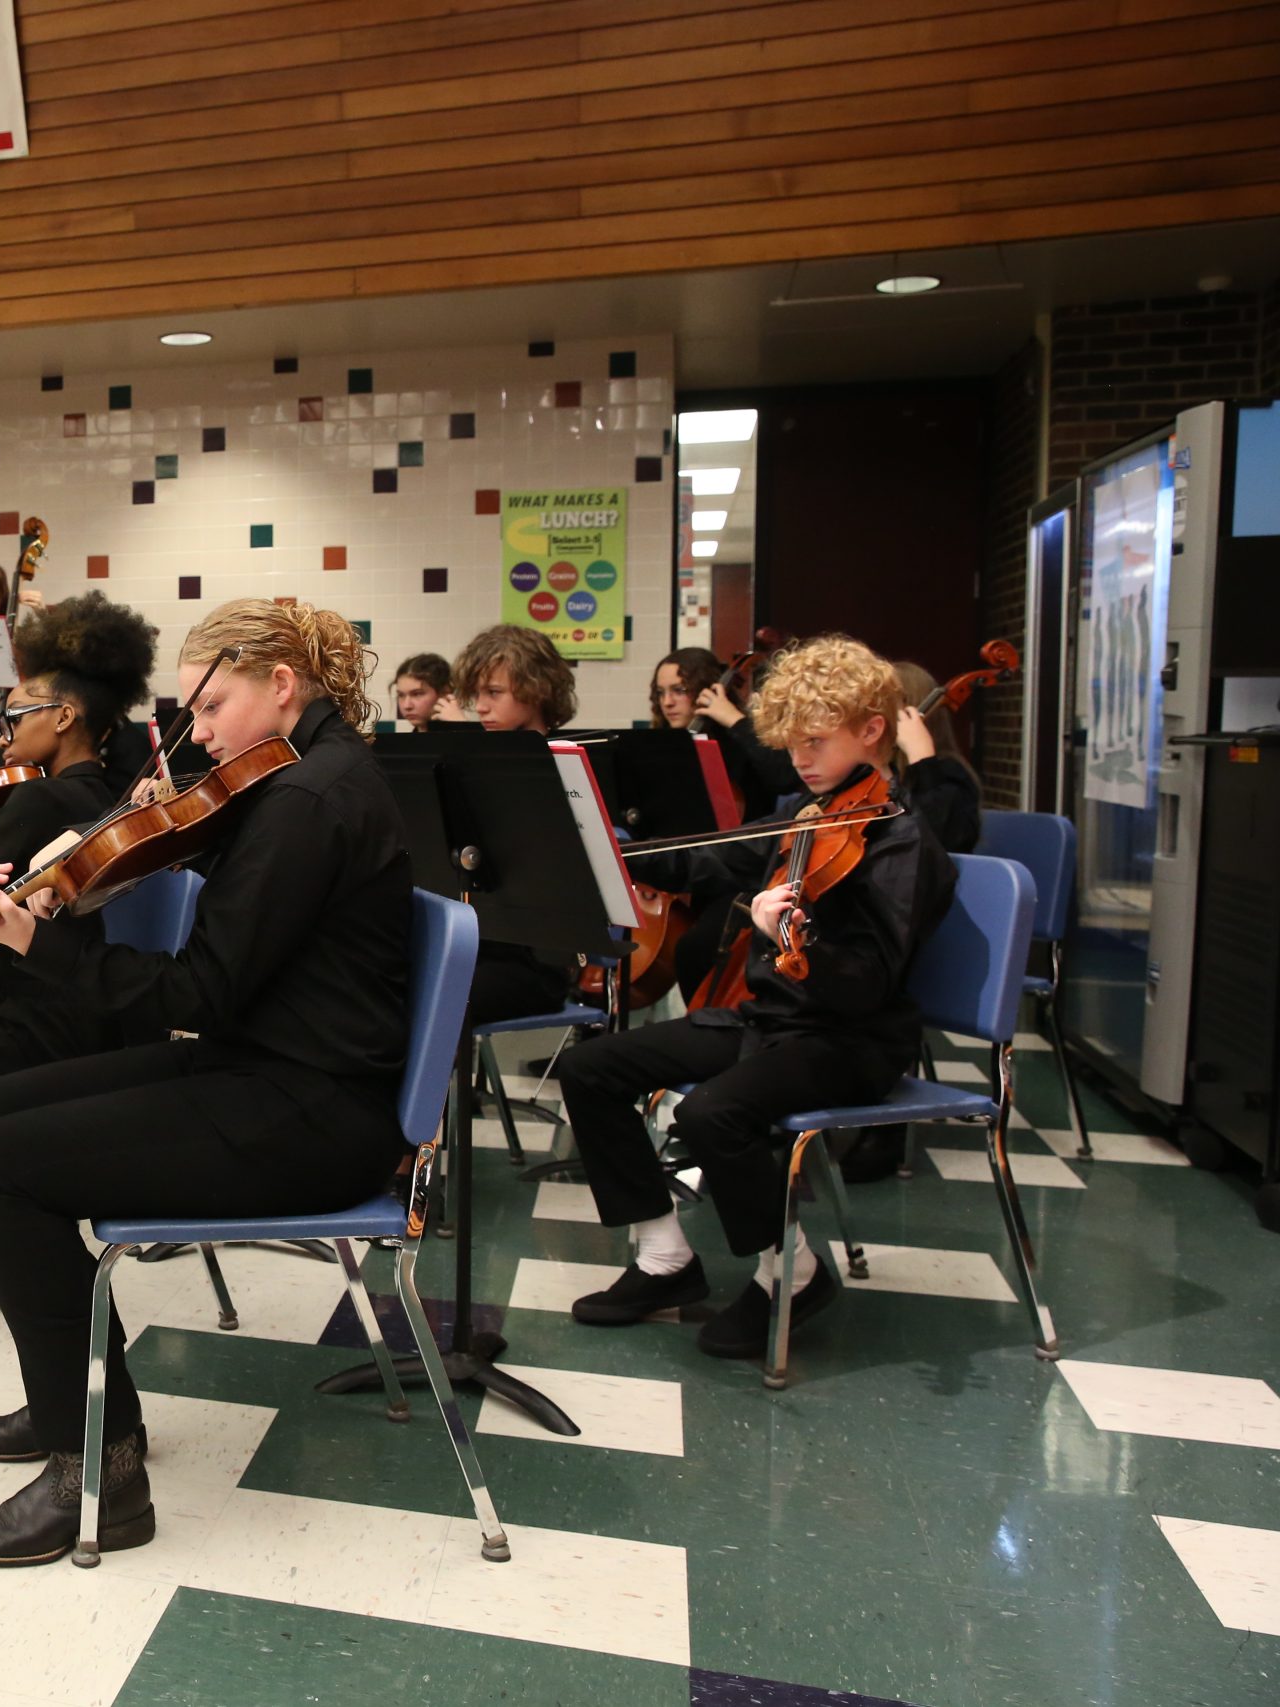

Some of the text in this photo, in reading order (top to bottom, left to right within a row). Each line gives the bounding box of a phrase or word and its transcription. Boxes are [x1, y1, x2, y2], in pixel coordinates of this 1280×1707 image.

[508, 492, 619, 508] WHAT MAKES A
[540, 510, 619, 529] LUNCH?
[567, 601, 594, 612] Dairy
